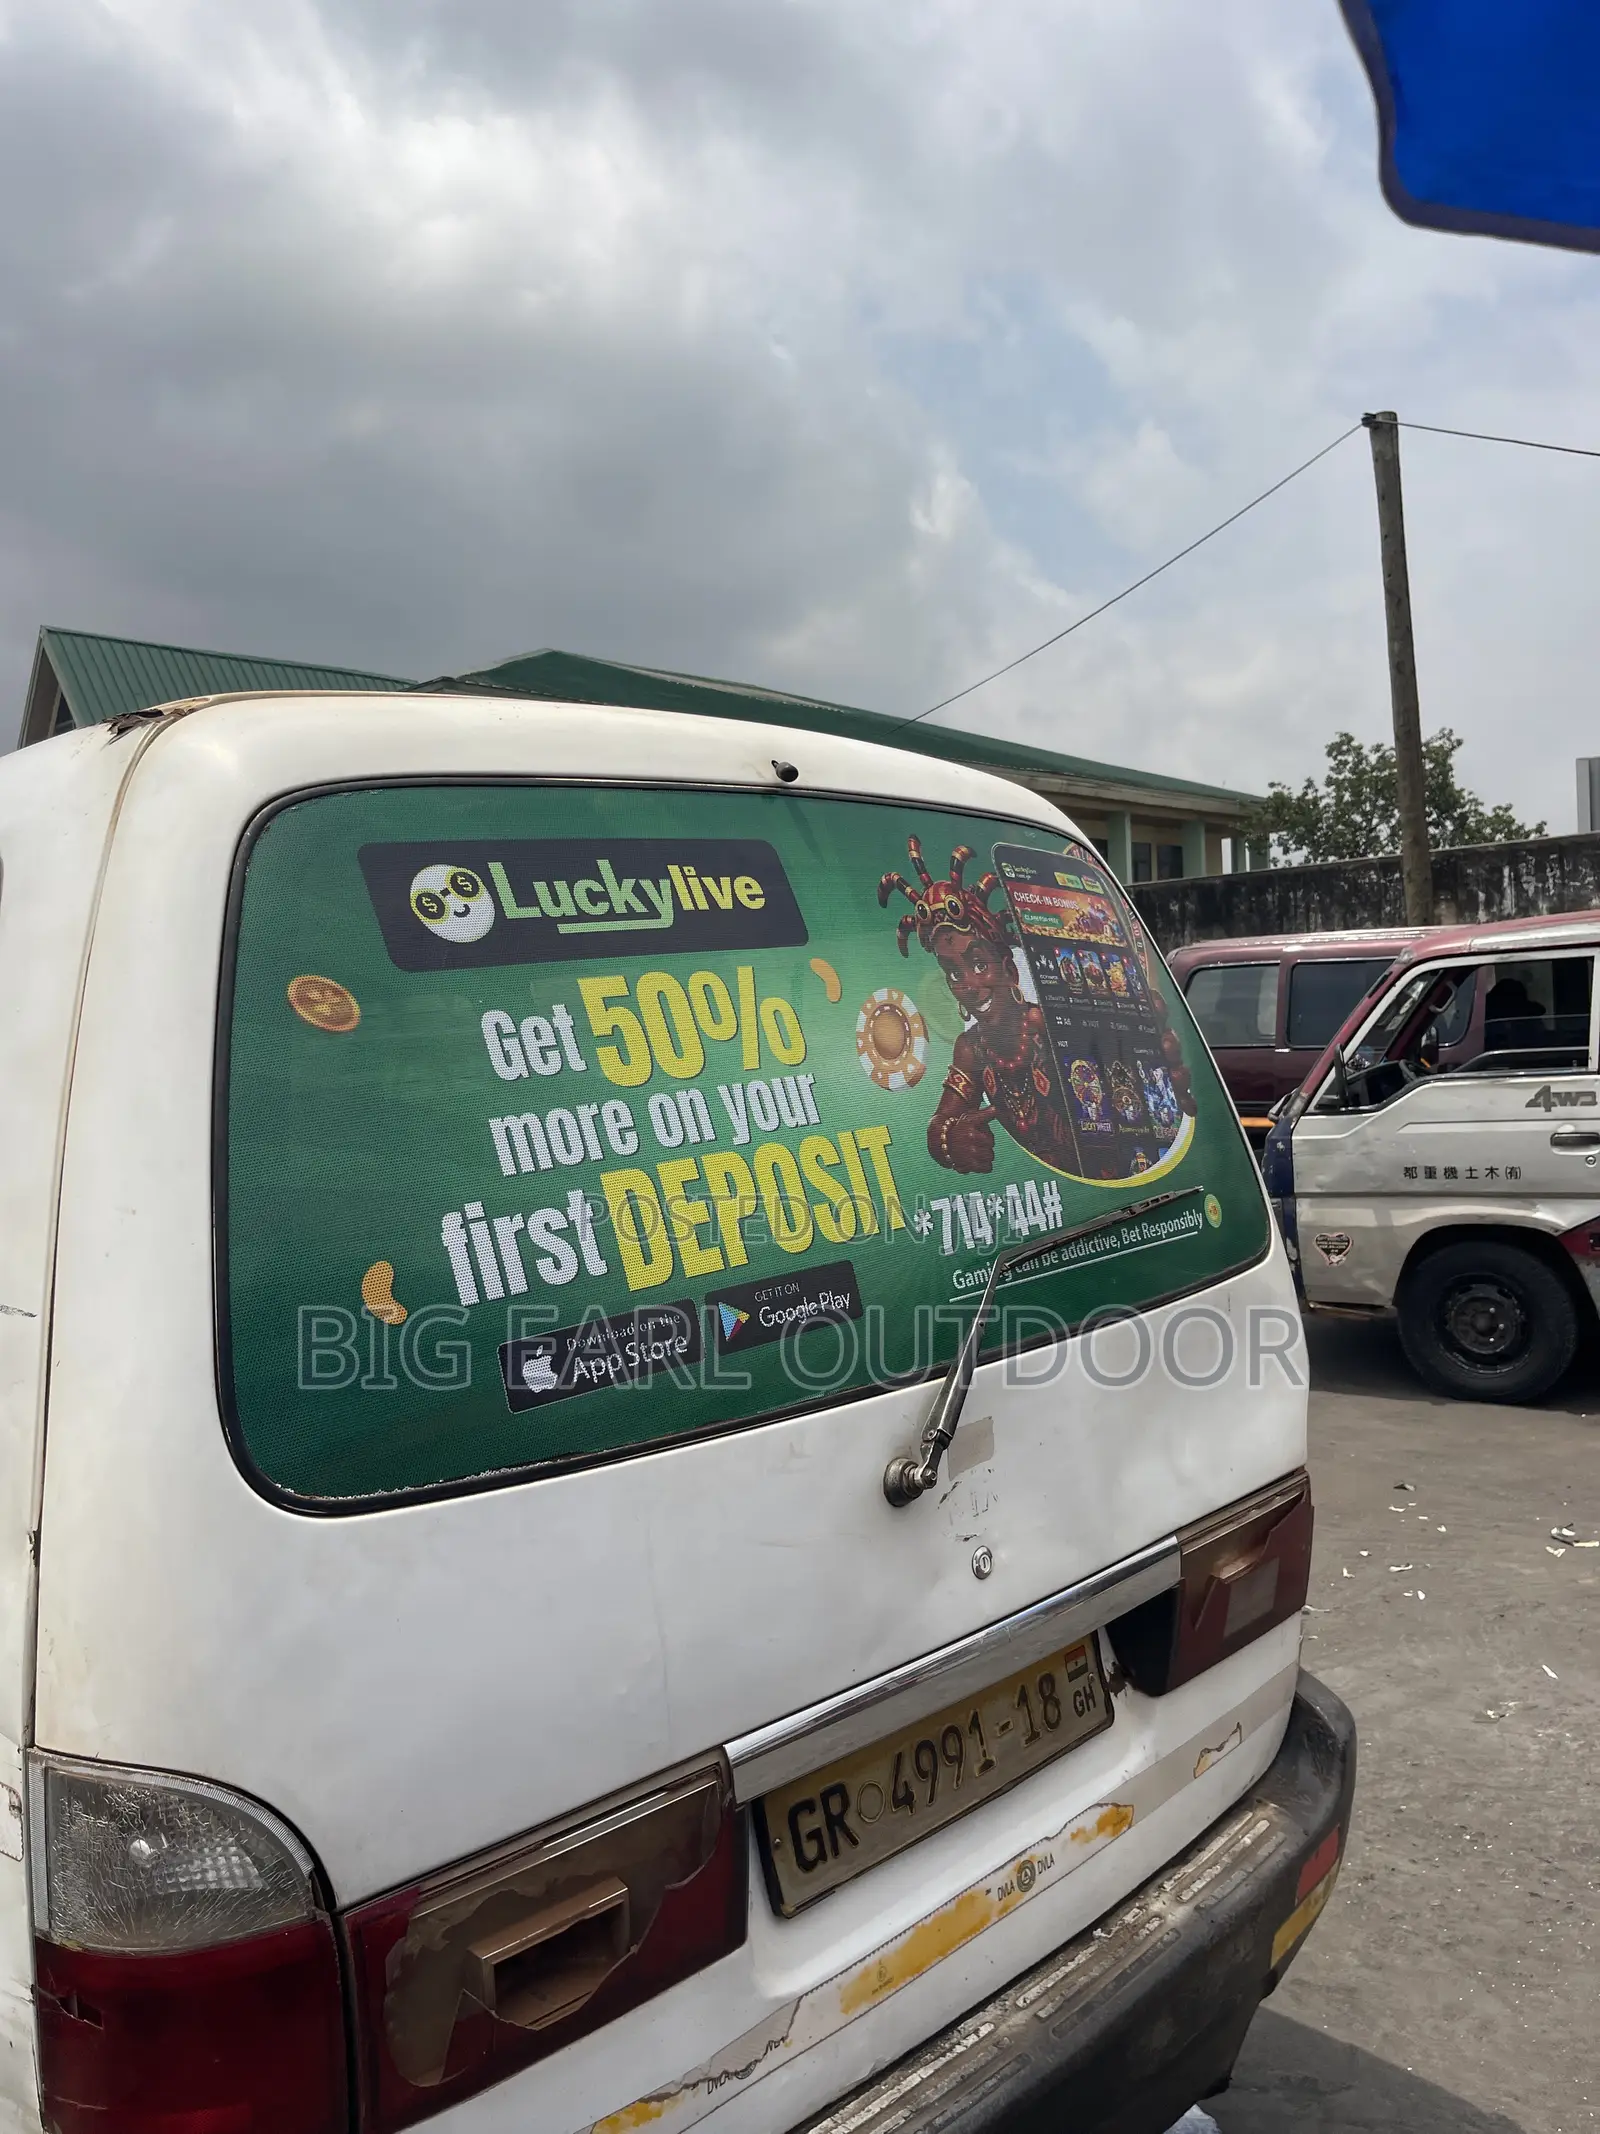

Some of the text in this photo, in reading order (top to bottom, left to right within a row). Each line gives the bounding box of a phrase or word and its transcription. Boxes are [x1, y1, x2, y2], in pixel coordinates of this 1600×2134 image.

[487, 859, 766, 934] Luckylive
[480, 966, 807, 1088] Get 50%
[489, 1073, 822, 1177] more on your
[1525, 1085, 1599, 1113] 4WD
[441, 1125, 907, 1306] first DEPOSIT
[952, 1258, 1013, 1290] Gamig
[1060, 1233, 1121, 1262] addictive,
[1121, 1218, 1142, 1247] Bet
[1142, 1208, 1203, 1242] Responsibly
[754, 1282, 800, 1302] GET IT ON
[759, 1290, 850, 1328] Google Play
[566, 1313, 680, 1352] Download on the
[573, 1335, 688, 1384] App Store
[1073, 1684, 1098, 1718] GH
[787, 1781, 860, 1873] GR
